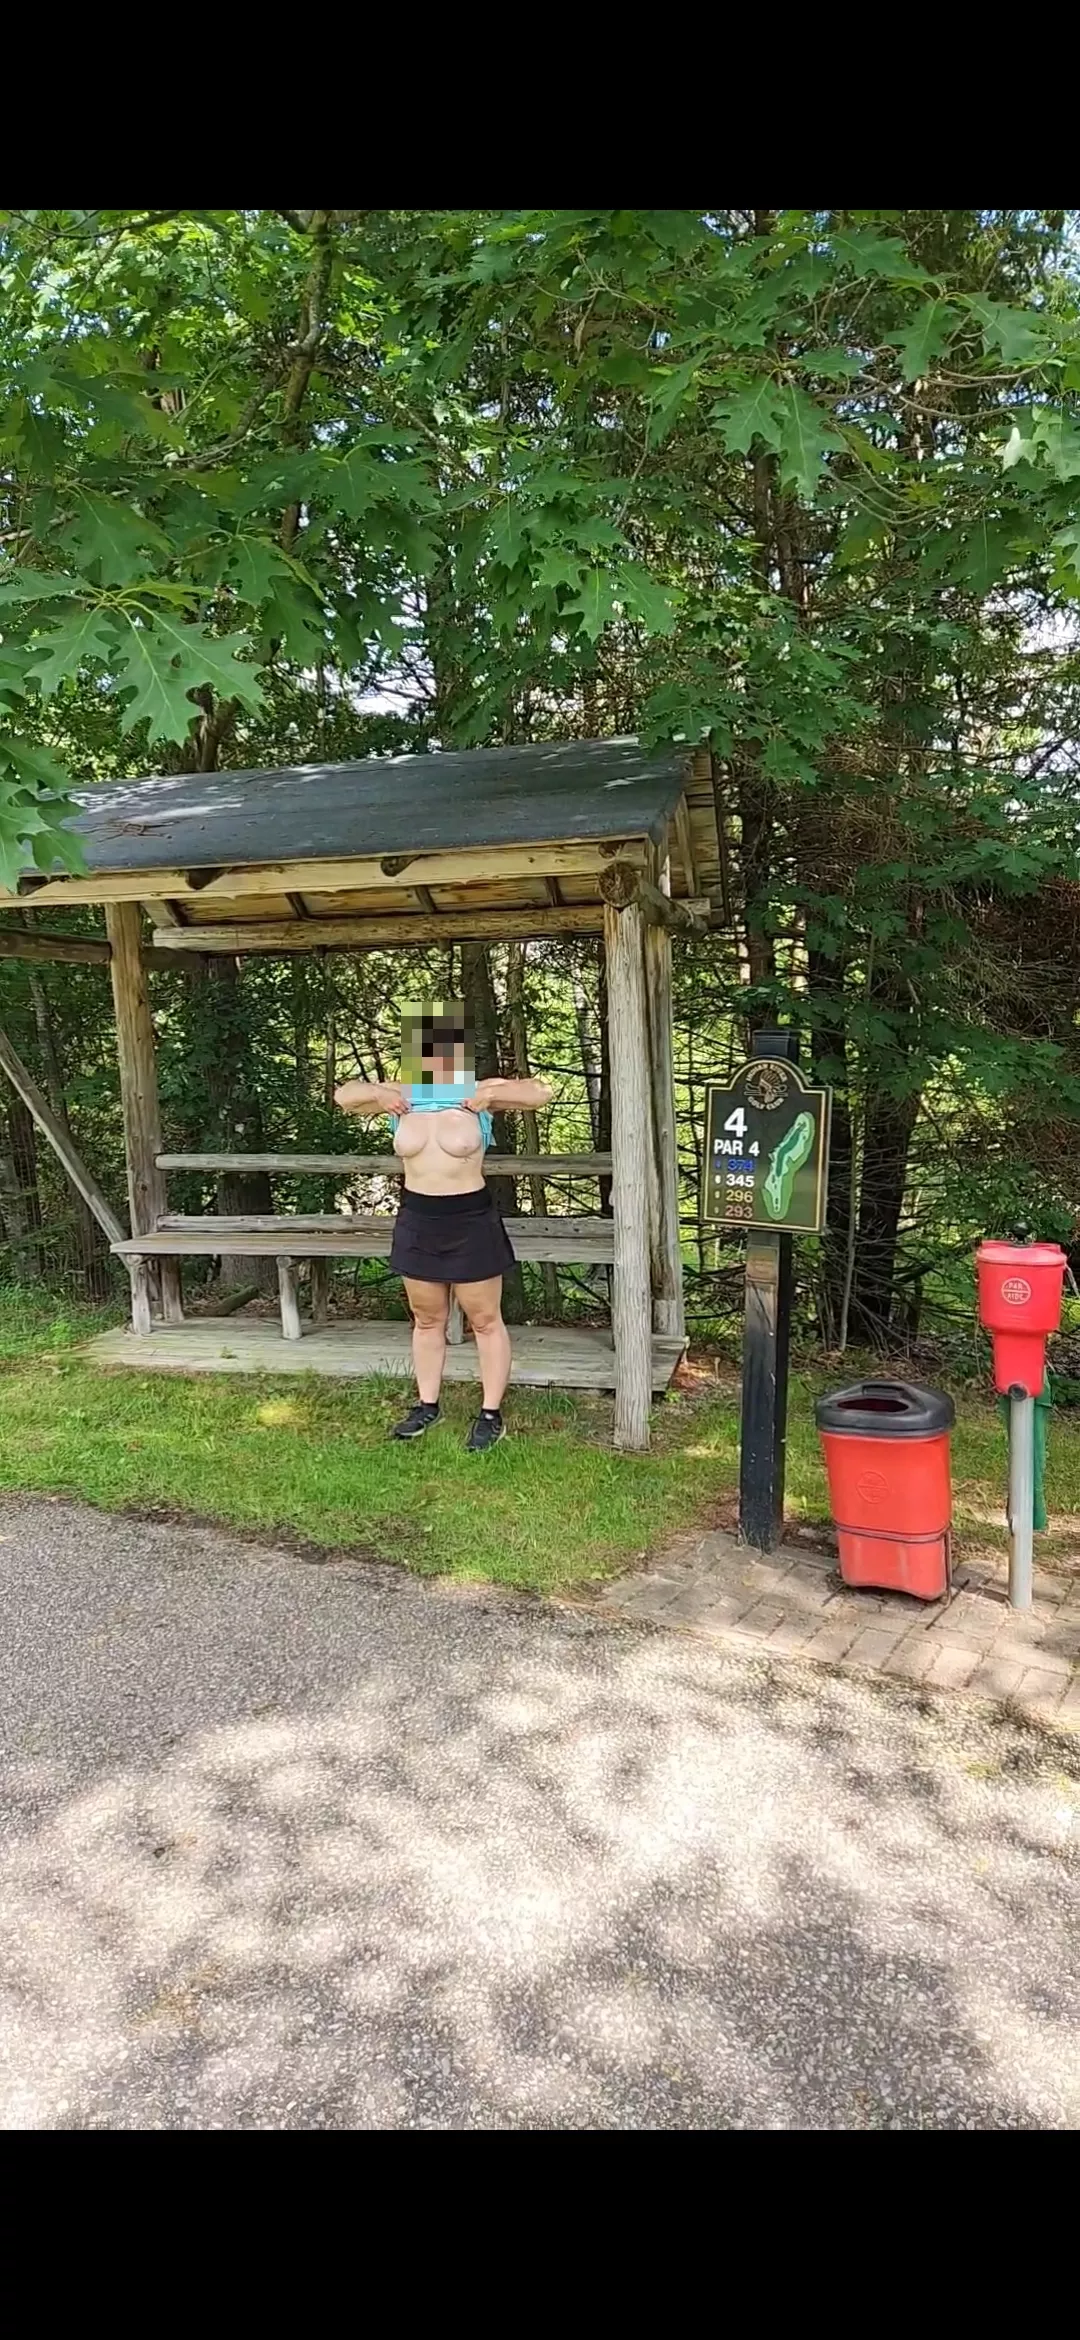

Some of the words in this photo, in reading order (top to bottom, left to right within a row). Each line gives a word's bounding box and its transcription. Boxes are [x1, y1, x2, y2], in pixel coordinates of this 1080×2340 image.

[747, 1096, 765, 1109] GOLF
[766, 1097, 784, 1110] CLUB
[724, 1107, 748, 1138] 4
[714, 1139, 743, 1156] PAR
[748, 1141, 760, 1157] 4
[728, 1159, 753, 1173] 374
[726, 1174, 755, 1188] 345
[725, 1189, 753, 1203] 296
[725, 1205, 753, 1219] 293
